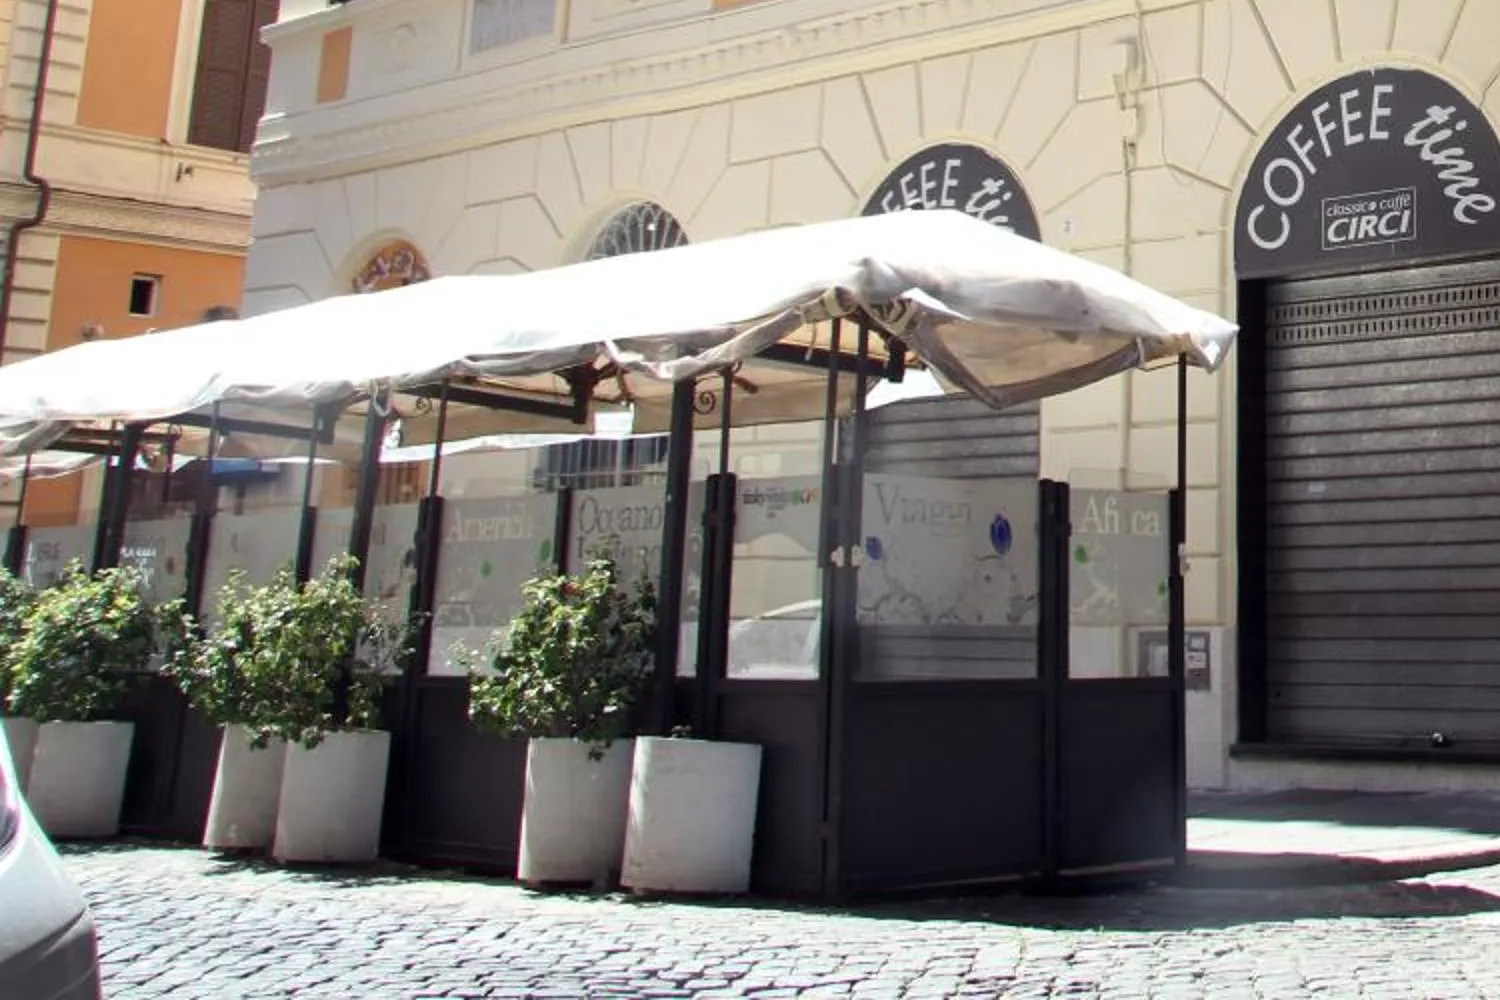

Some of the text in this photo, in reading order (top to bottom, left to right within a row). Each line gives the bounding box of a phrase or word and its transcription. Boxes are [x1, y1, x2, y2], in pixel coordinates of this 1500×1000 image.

[1247, 84, 1496, 250] COFFEE time
[1327, 209, 1411, 243] CIRCI
